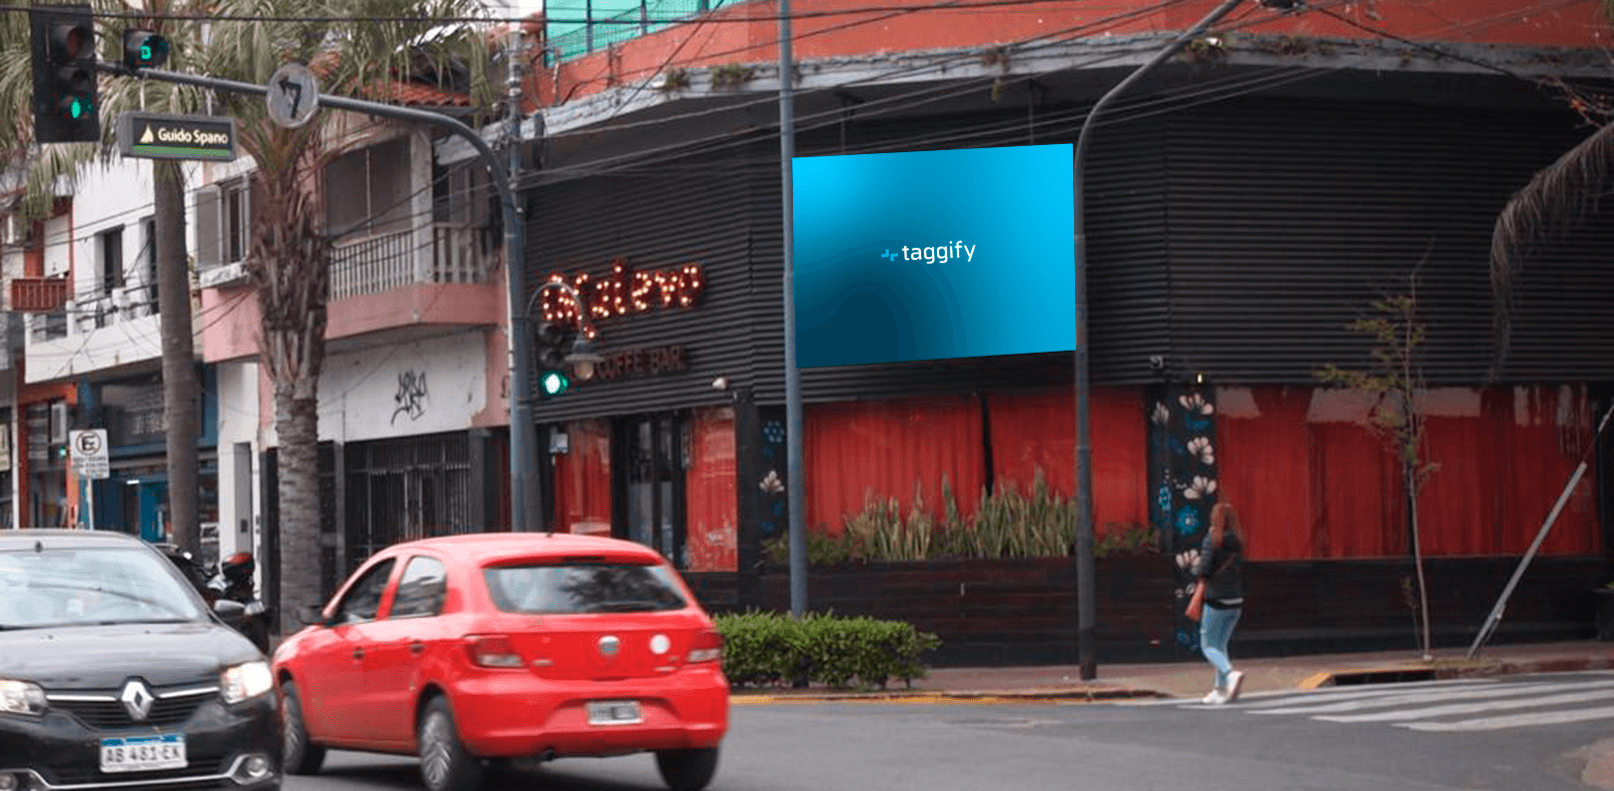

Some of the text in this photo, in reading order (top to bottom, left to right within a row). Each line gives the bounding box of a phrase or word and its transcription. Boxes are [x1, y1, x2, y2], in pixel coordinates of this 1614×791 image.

[158, 127, 229, 147] Guido Spano
[901, 240, 976, 264] taggify
